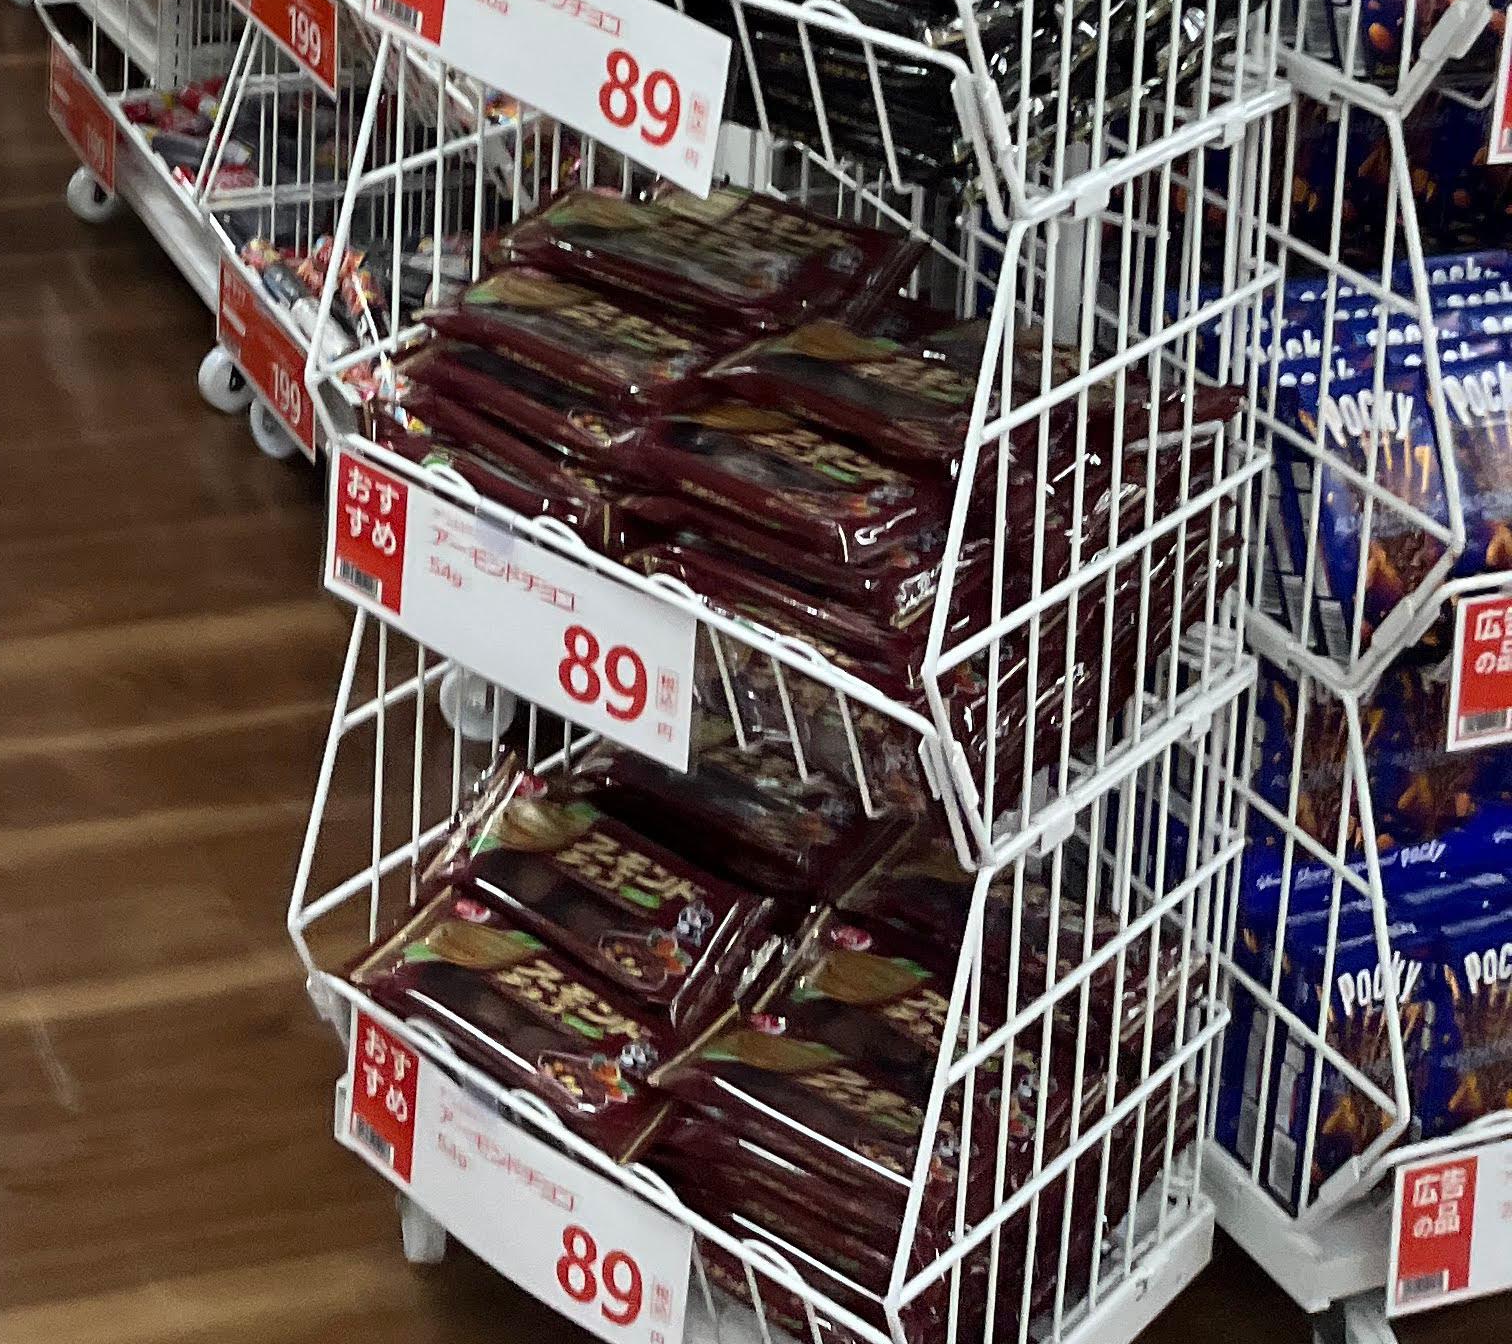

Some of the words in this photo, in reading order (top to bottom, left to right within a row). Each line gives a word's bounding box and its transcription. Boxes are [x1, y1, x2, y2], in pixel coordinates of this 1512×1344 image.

[289, 4, 322, 67] 199
[598, 48, 681, 148] 89
[271, 361, 303, 426] 199
[1474, 609, 1512, 641] 広
[558, 624, 648, 722] 89
[555, 1224, 643, 1326] 89
